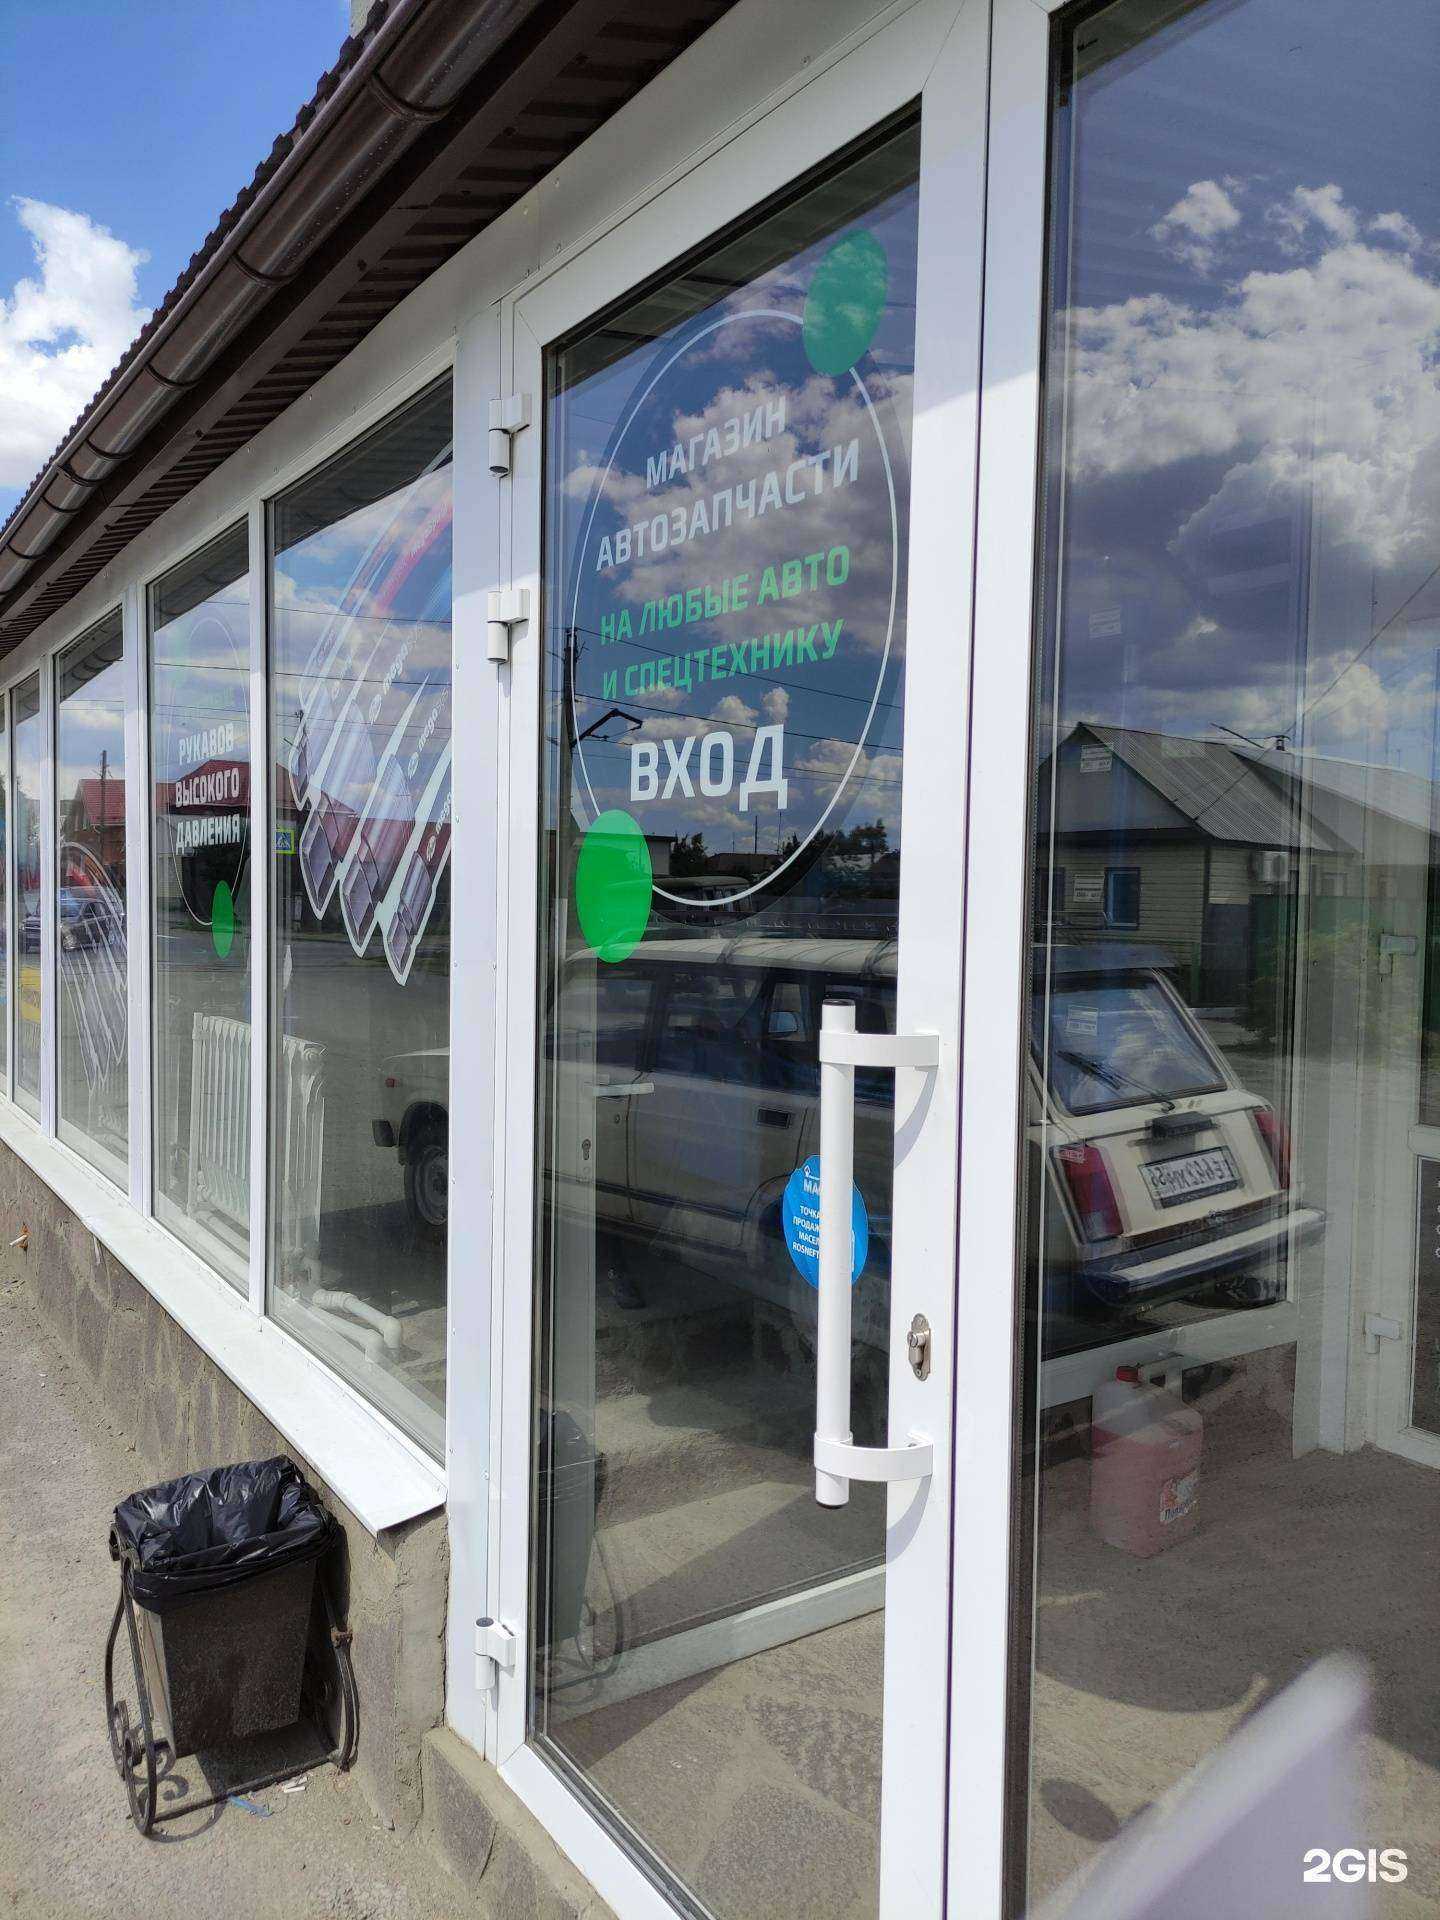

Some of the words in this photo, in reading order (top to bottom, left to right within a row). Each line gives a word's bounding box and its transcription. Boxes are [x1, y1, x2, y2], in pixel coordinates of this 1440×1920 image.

[646, 396, 787, 488] МАГАЗИН
[596, 438, 859, 571] АВТОЗАПЧАСТИ
[601, 609, 633, 645] НА
[638, 573, 749, 635] ЛЮБЫЕ
[757, 545, 851, 601] АВТО
[602, 668, 618, 700] И
[623, 618, 845, 697] СПЕЦТЕХНИКУ
[178, 723, 235, 765] РУКАВОВ
[630, 724, 788, 812] ВХОД
[175, 767, 240, 808] ВЫСОКОГО
[175, 813, 240, 855] ДАВЛЕНИЯ
